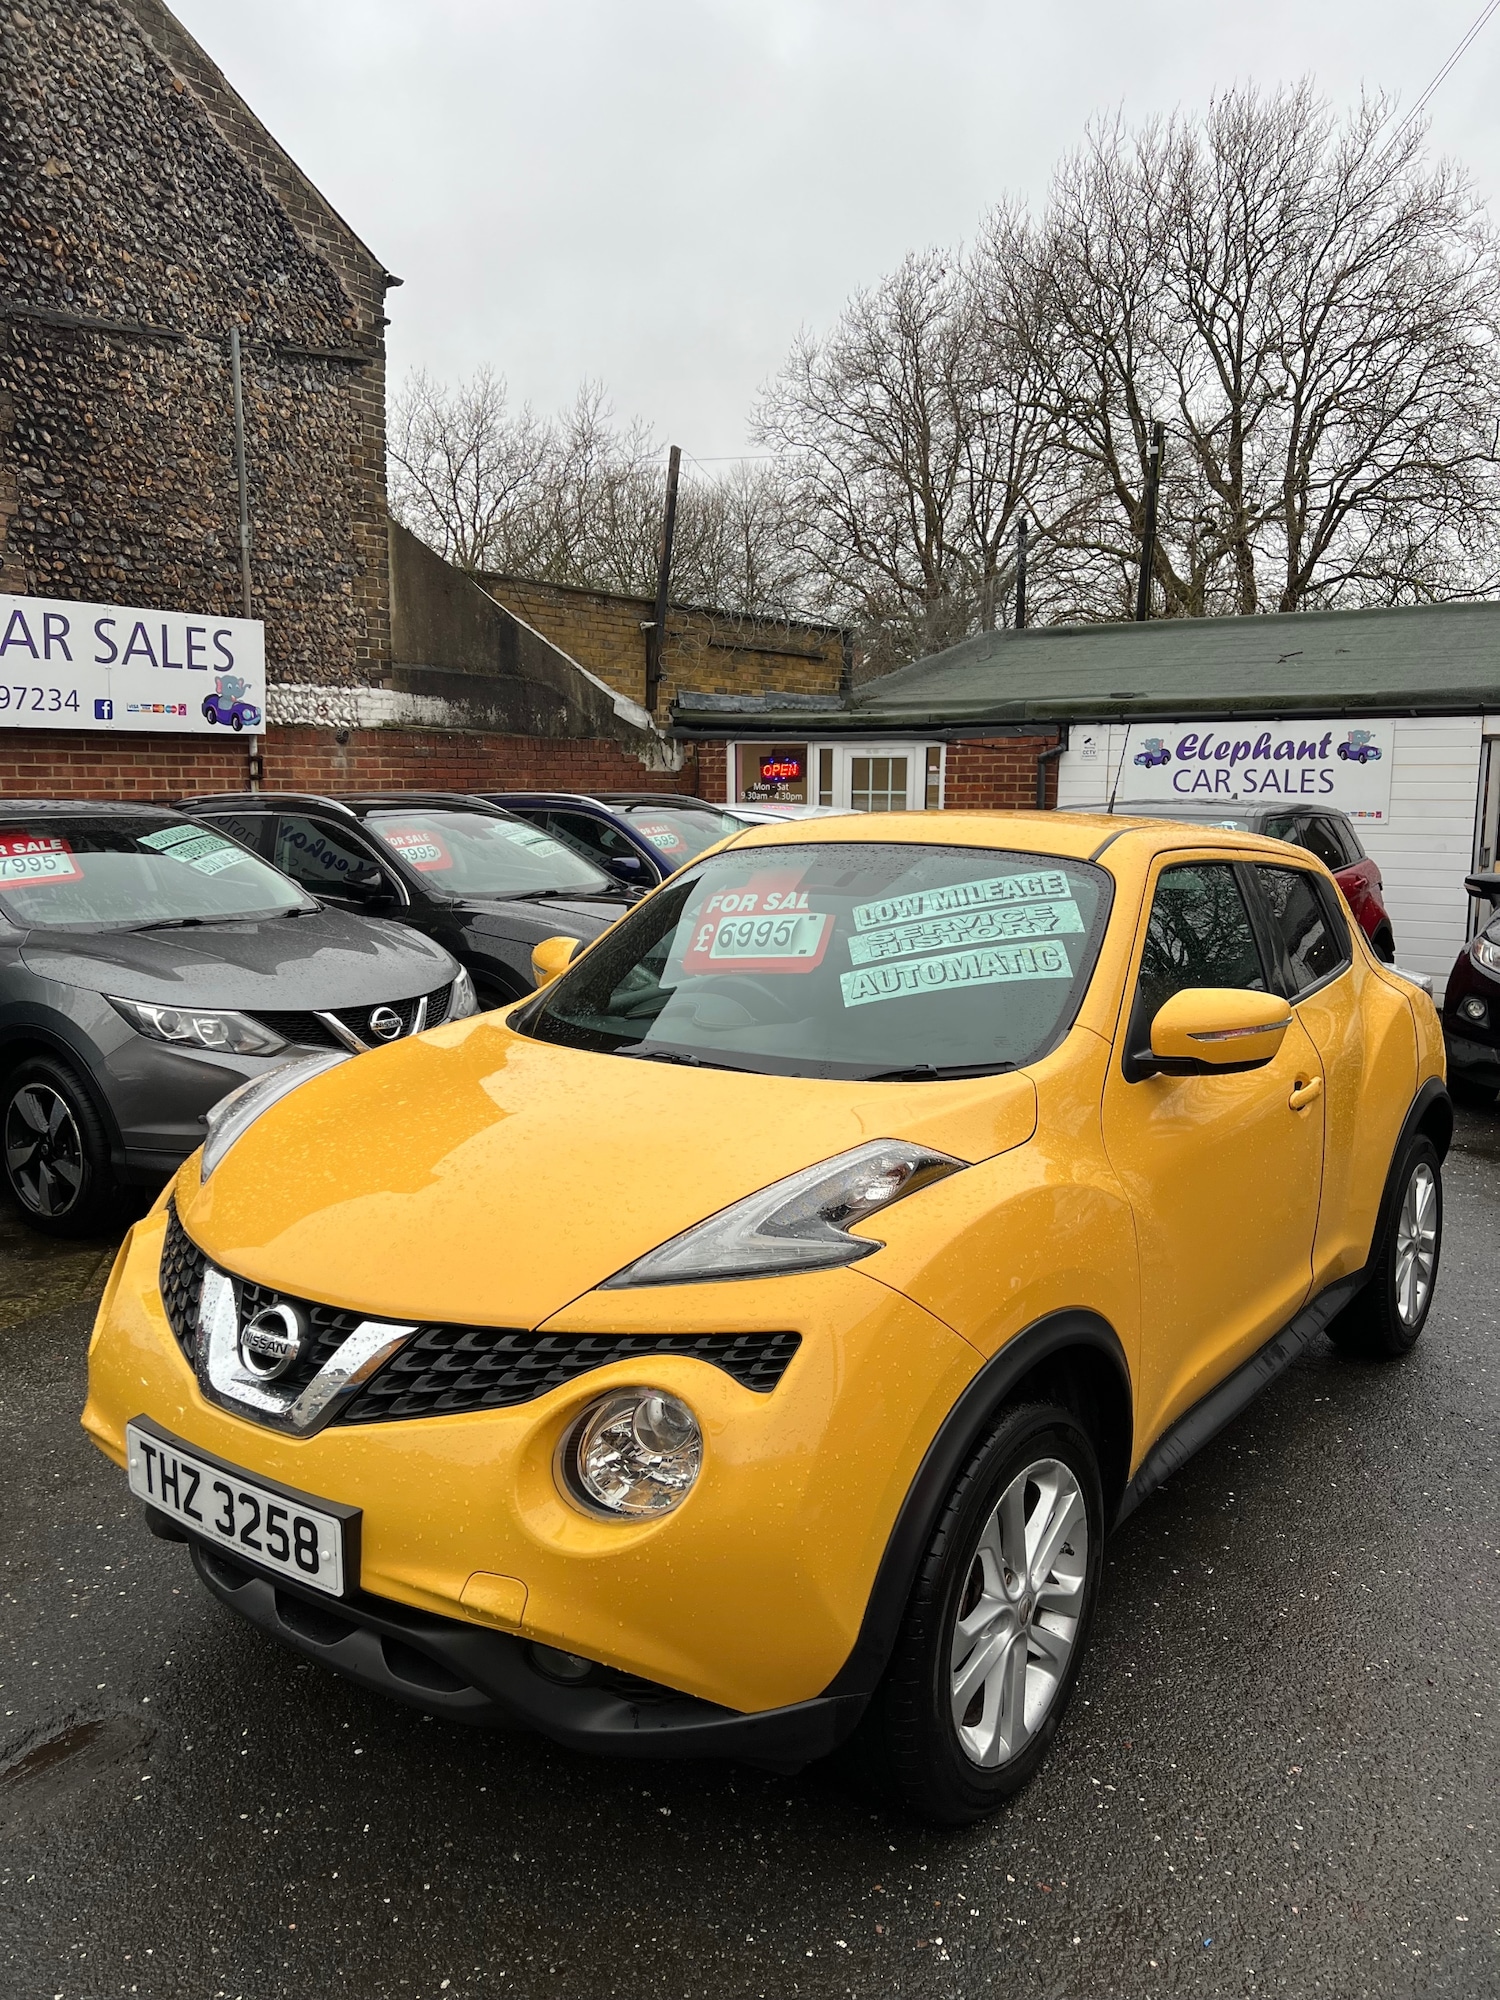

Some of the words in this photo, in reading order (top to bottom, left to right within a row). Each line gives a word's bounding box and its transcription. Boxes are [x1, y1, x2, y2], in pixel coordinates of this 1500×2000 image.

[94, 618, 234, 672] SALES
[1175, 732, 1333, 768] Elephant
[763, 763, 798, 776] OPEN
[1173, 769, 1231, 793] CAR
[1243, 768, 1334, 793] SALES
[741, 791, 768, 800] 9.30am
[774, 792, 803, 802] 4.30pm
[753, 783, 770, 791] Mon
[777, 783, 789, 791] Sat
[12, 839, 63, 854] SALE
[405, 833, 430, 844] SALE
[706, 893, 759, 914] FOR
[762, 891, 809, 911] SAL
[858, 896, 924, 926] LOW
[929, 874, 1066, 910] MILEAGE
[867, 905, 1055, 944] SERVICE
[869, 916, 1061, 957] HISTORY
[851, 946, 1062, 999] AUTOMATIC
[245, 1331, 288, 1355] NISSAN
[140, 1441, 203, 1524] THZ
[213, 1481, 319, 1575] 3258
